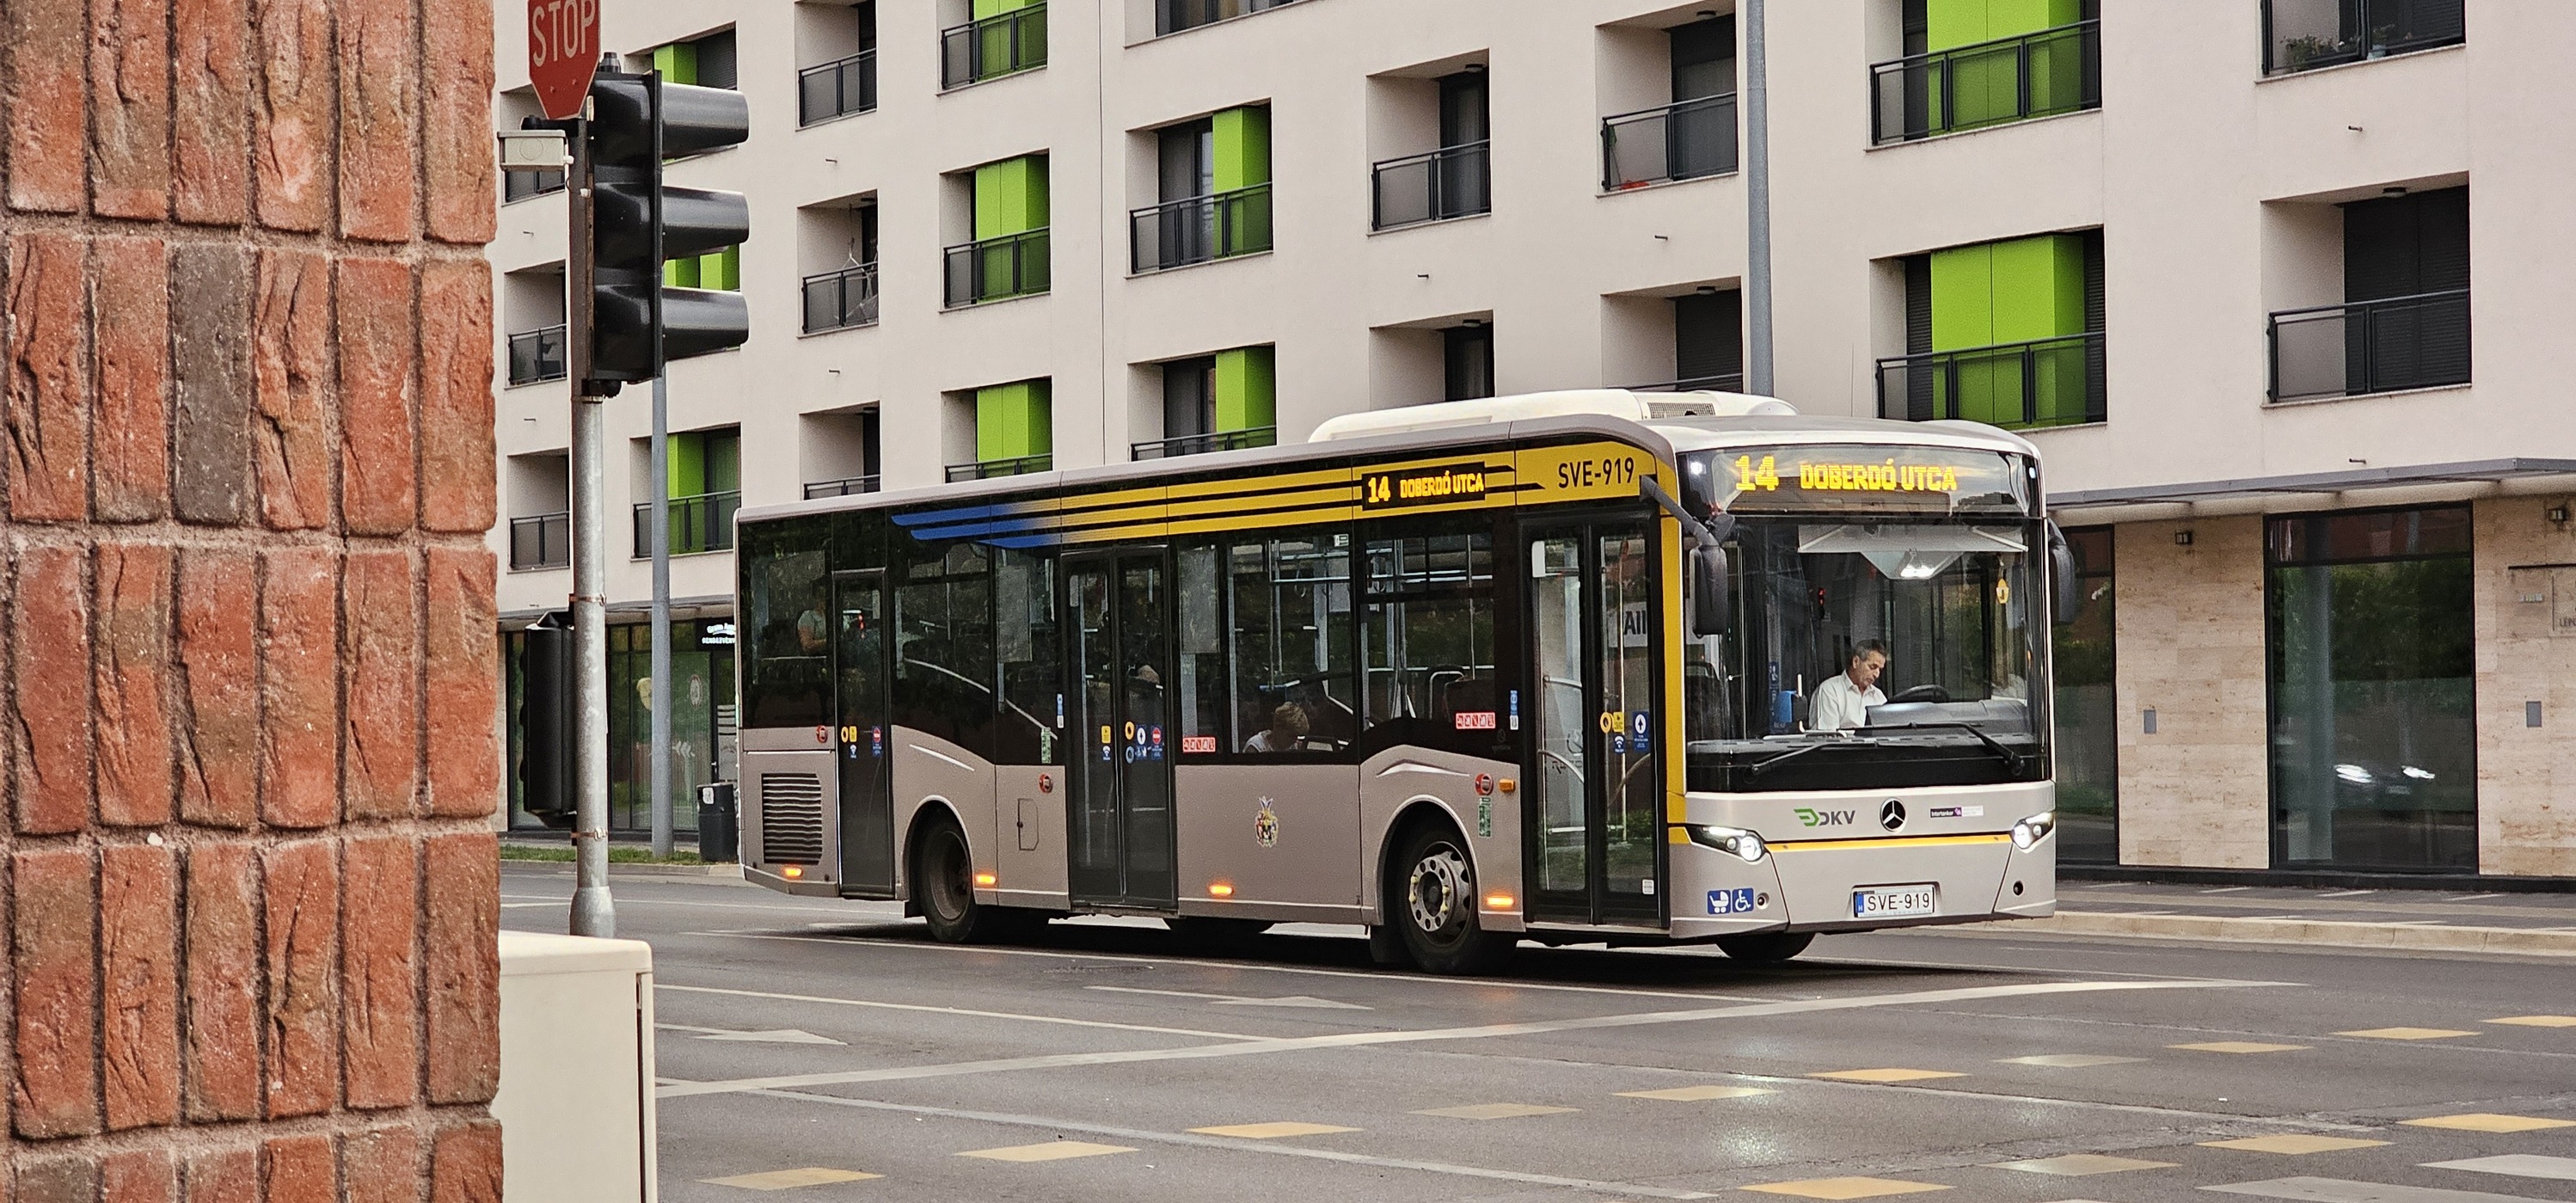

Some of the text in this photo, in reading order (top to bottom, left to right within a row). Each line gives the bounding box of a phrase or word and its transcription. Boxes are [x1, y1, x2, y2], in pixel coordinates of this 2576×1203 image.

[532, 0, 596, 67] STOP
[1368, 470, 1484, 503] 14 DOBERDÓ UTCA
[1558, 457, 1635, 488] SVE-919
[1735, 455, 1957, 491] 14 DOBERDÓ UTCA
[1819, 810, 1856, 826] DKV
[1868, 893, 1929, 911] SVE-919
